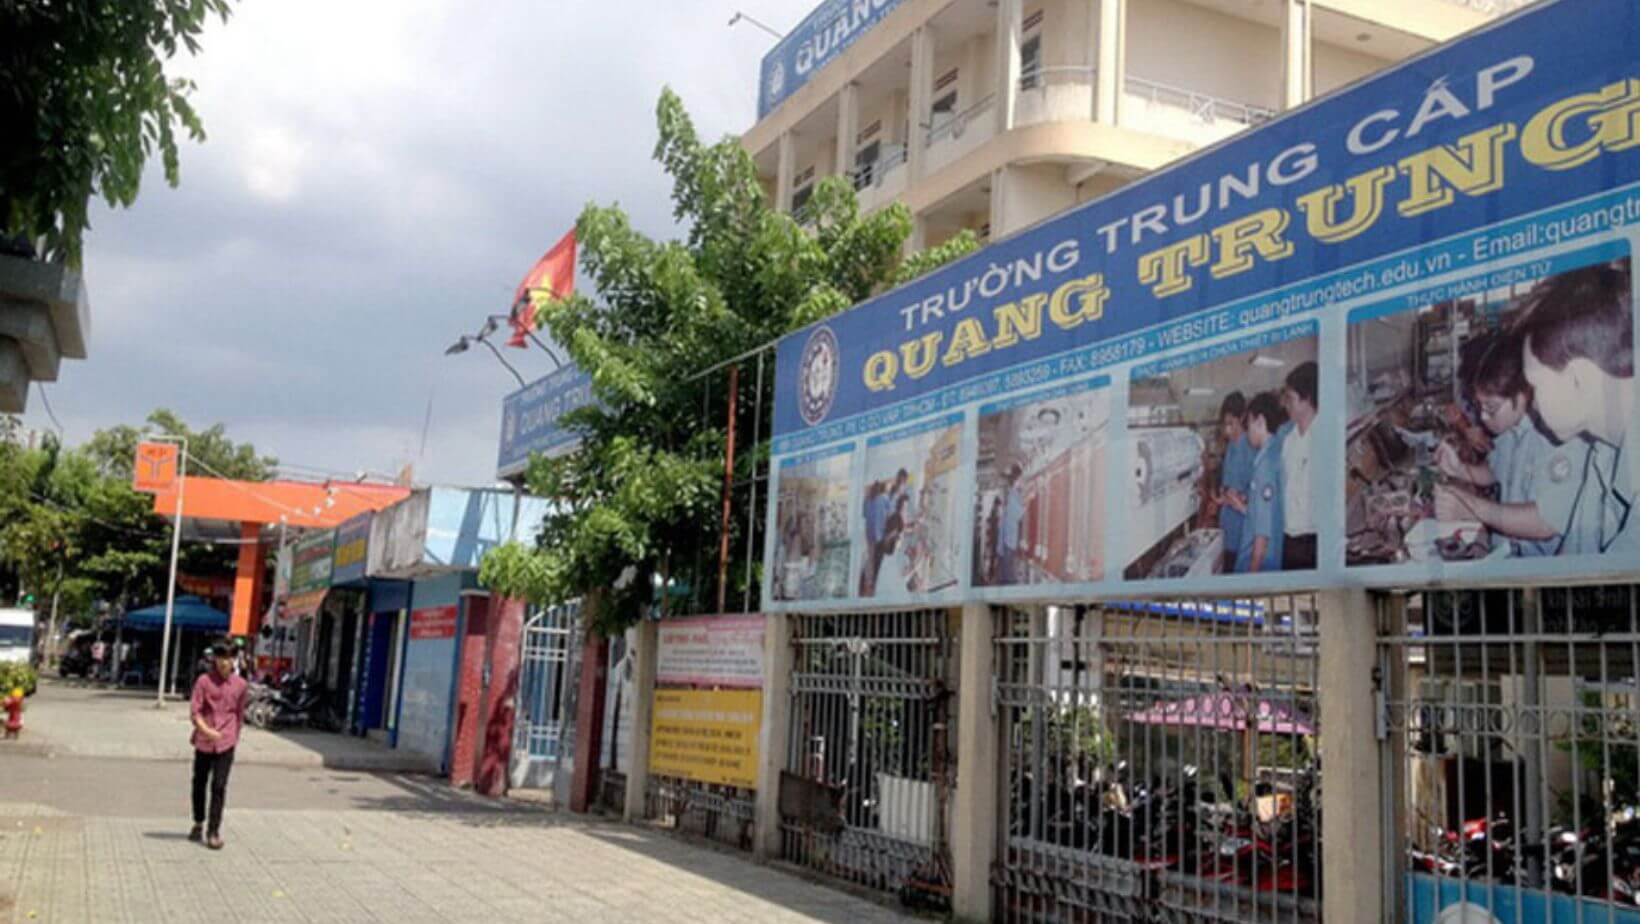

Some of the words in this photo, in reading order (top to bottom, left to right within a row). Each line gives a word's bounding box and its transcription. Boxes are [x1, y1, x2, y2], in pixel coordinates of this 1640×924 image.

[863, 272, 1110, 394] QUANG
[1137, 78, 1640, 300] TRUNG
[901, 239, 1080, 333] TRƯỜNG
[1096, 143, 1319, 254] TRUNG
[1345, 54, 1535, 156] CẤP
[1239, 252, 1451, 326] quangtrungtech.edu.vn
